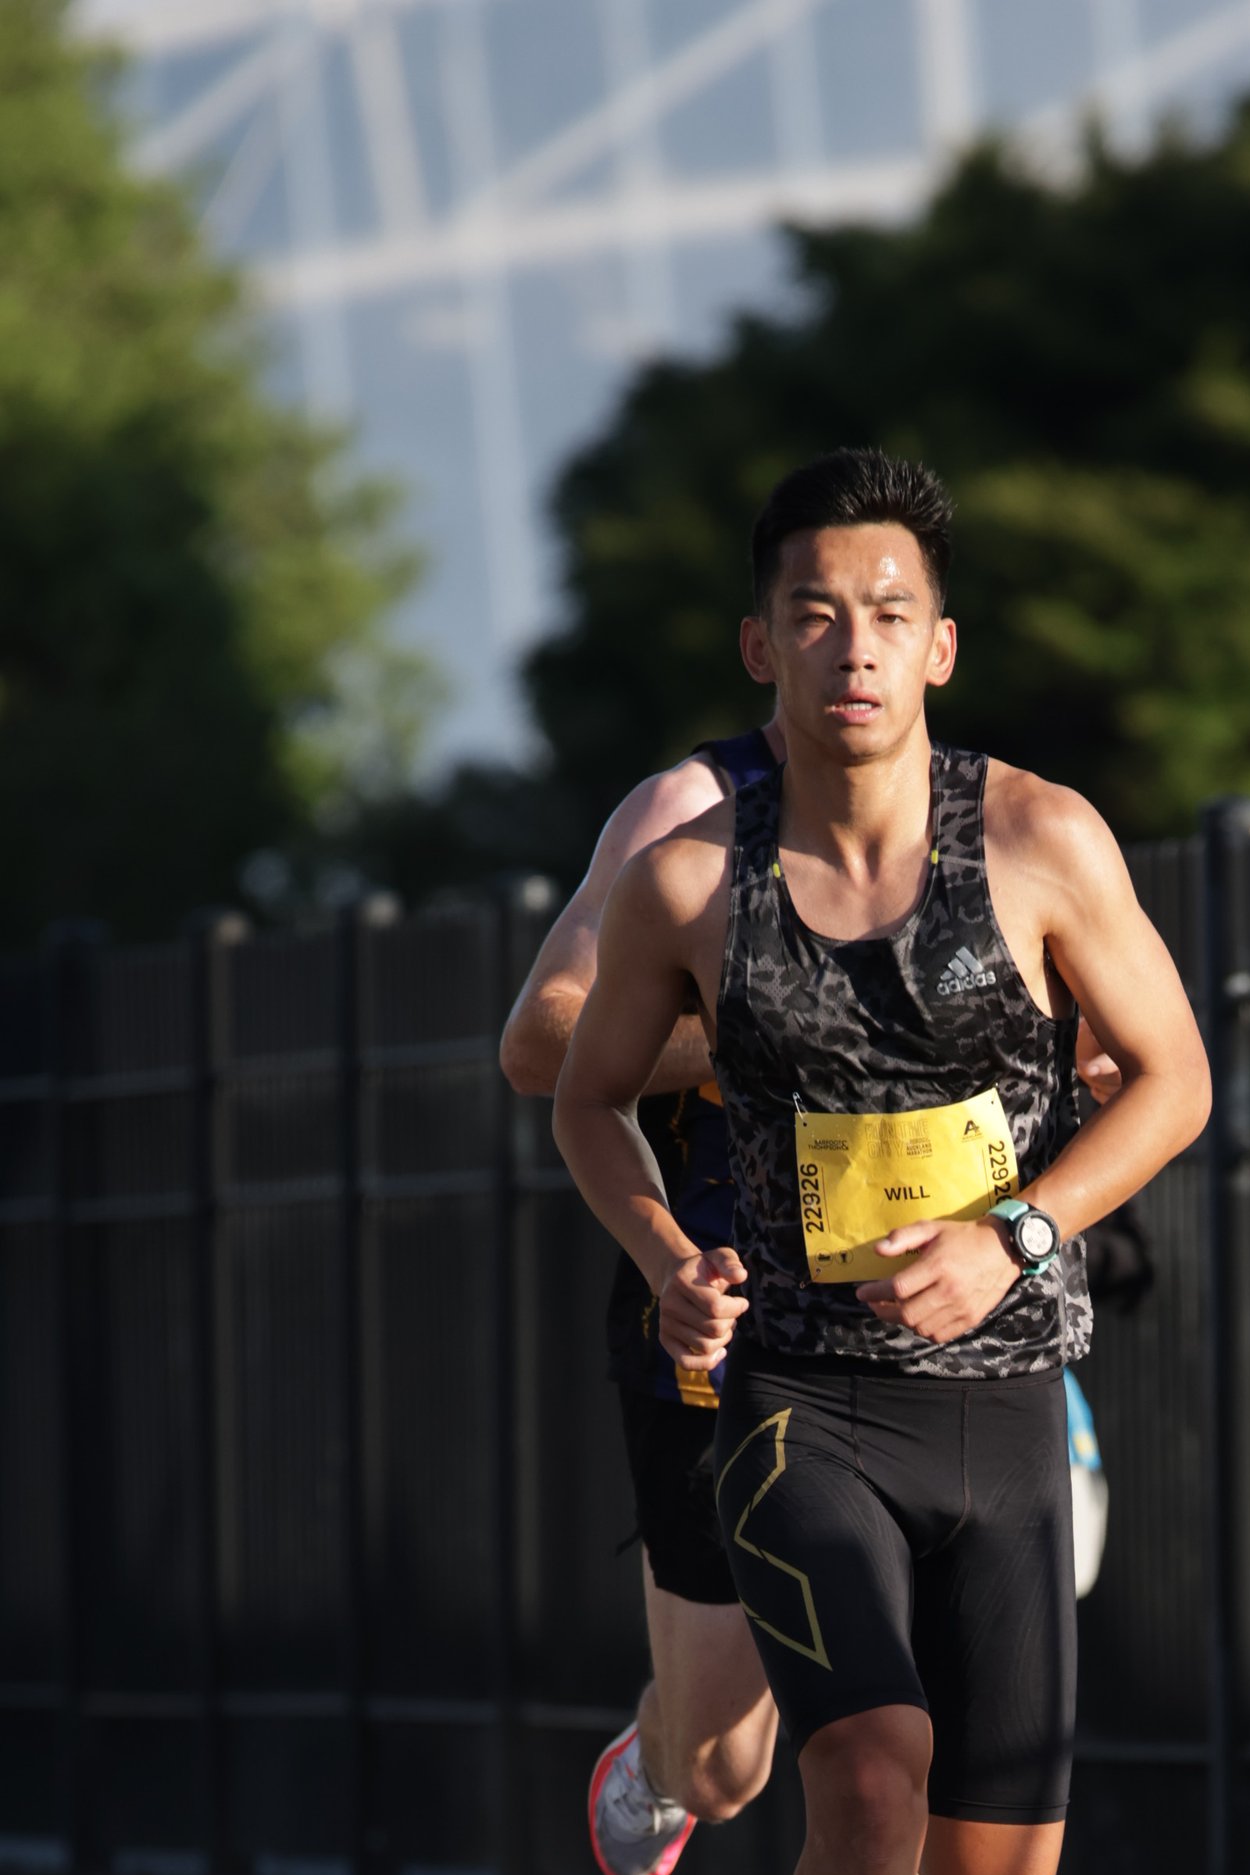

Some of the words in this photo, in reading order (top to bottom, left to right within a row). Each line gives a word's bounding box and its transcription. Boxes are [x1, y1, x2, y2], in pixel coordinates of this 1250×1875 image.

[937, 971, 996, 995] adidas
[800, 1163, 825, 1233] 22926
[884, 1186, 931, 1201] WILL
